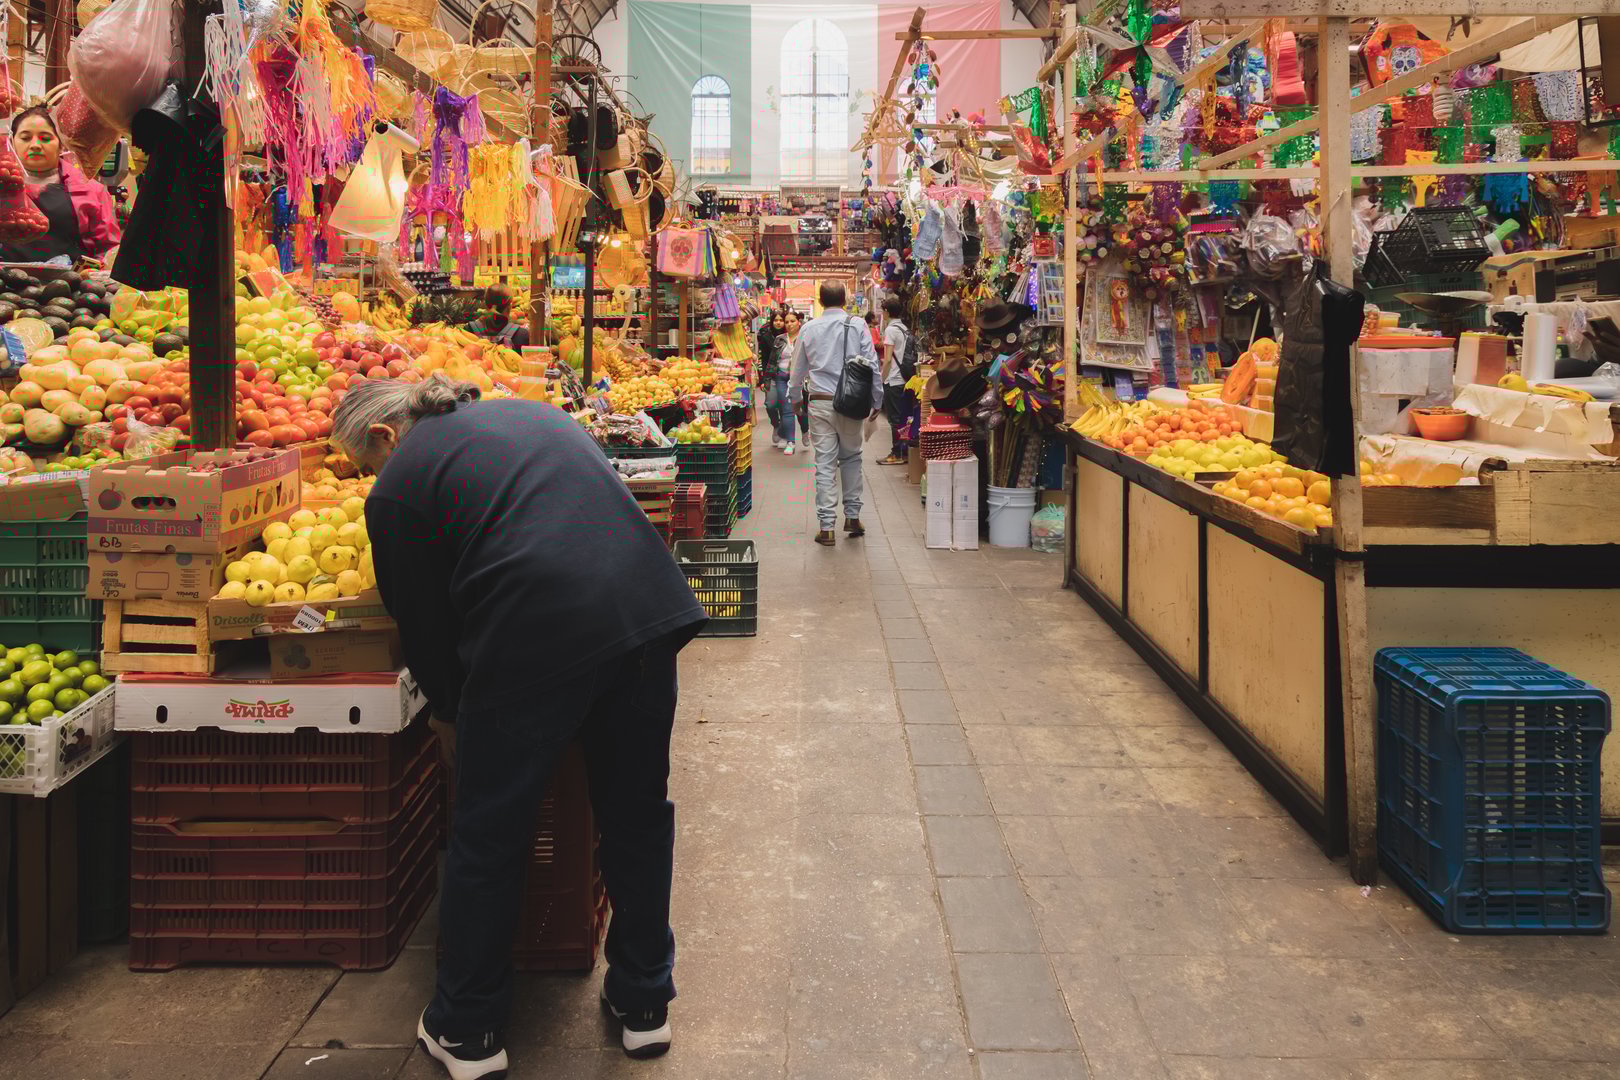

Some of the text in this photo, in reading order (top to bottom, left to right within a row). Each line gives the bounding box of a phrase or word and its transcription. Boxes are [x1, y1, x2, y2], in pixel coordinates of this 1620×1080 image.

[247, 464, 271, 481] Frutas
[106, 519, 149, 533] Frutas
[297, 619, 315, 632] ITEM
[225, 700, 294, 719] PRIMA
